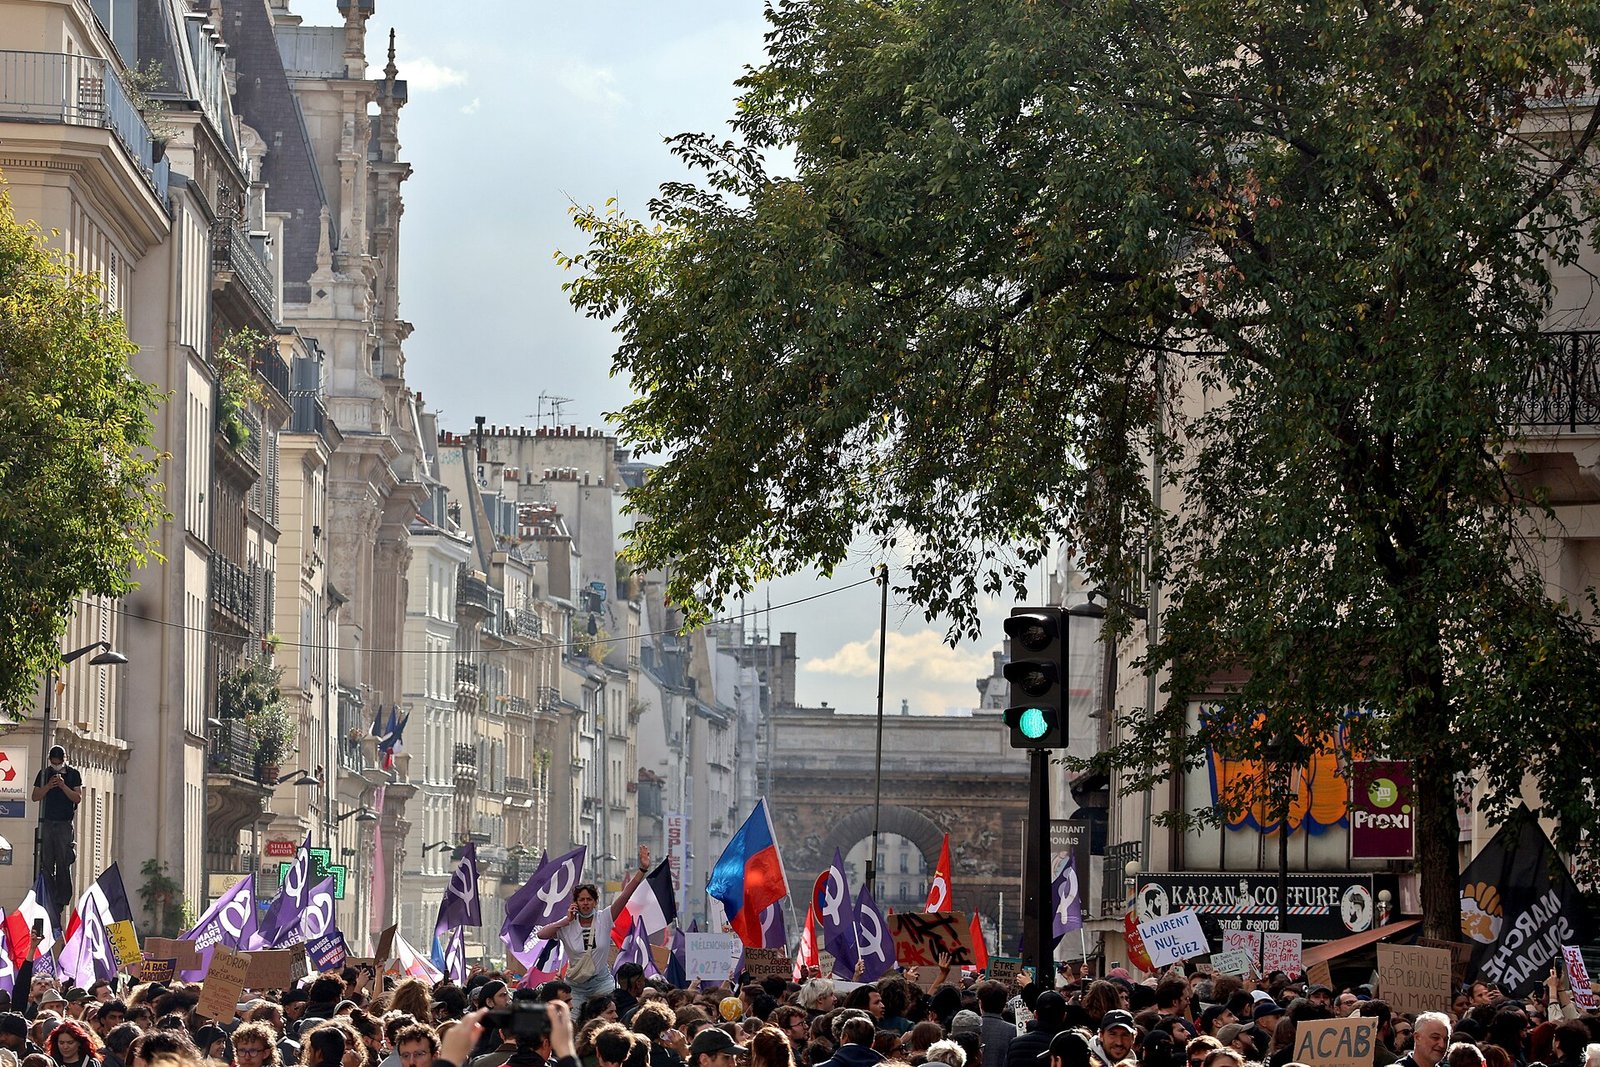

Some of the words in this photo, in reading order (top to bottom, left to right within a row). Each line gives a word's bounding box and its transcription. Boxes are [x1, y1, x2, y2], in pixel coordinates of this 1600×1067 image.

[1354, 804, 1411, 829] Proxi
[1171, 885, 1236, 906] KARAN
[1254, 885, 1340, 906] COFFURE
[1141, 914, 1189, 939] LAURENT
[1154, 934, 1180, 951] NUL
[1170, 941, 1200, 958] GUEZ
[1230, 933, 1246, 947] On
[745, 947, 777, 960] REGARDE
[1392, 950, 1429, 969] ENFIN
[1435, 956, 1449, 970] LA
[993, 959, 1015, 970] ÊTRE
[1379, 964, 1450, 991] RÉPUBLIQUE
[1408, 992, 1452, 1011] MARCHE
